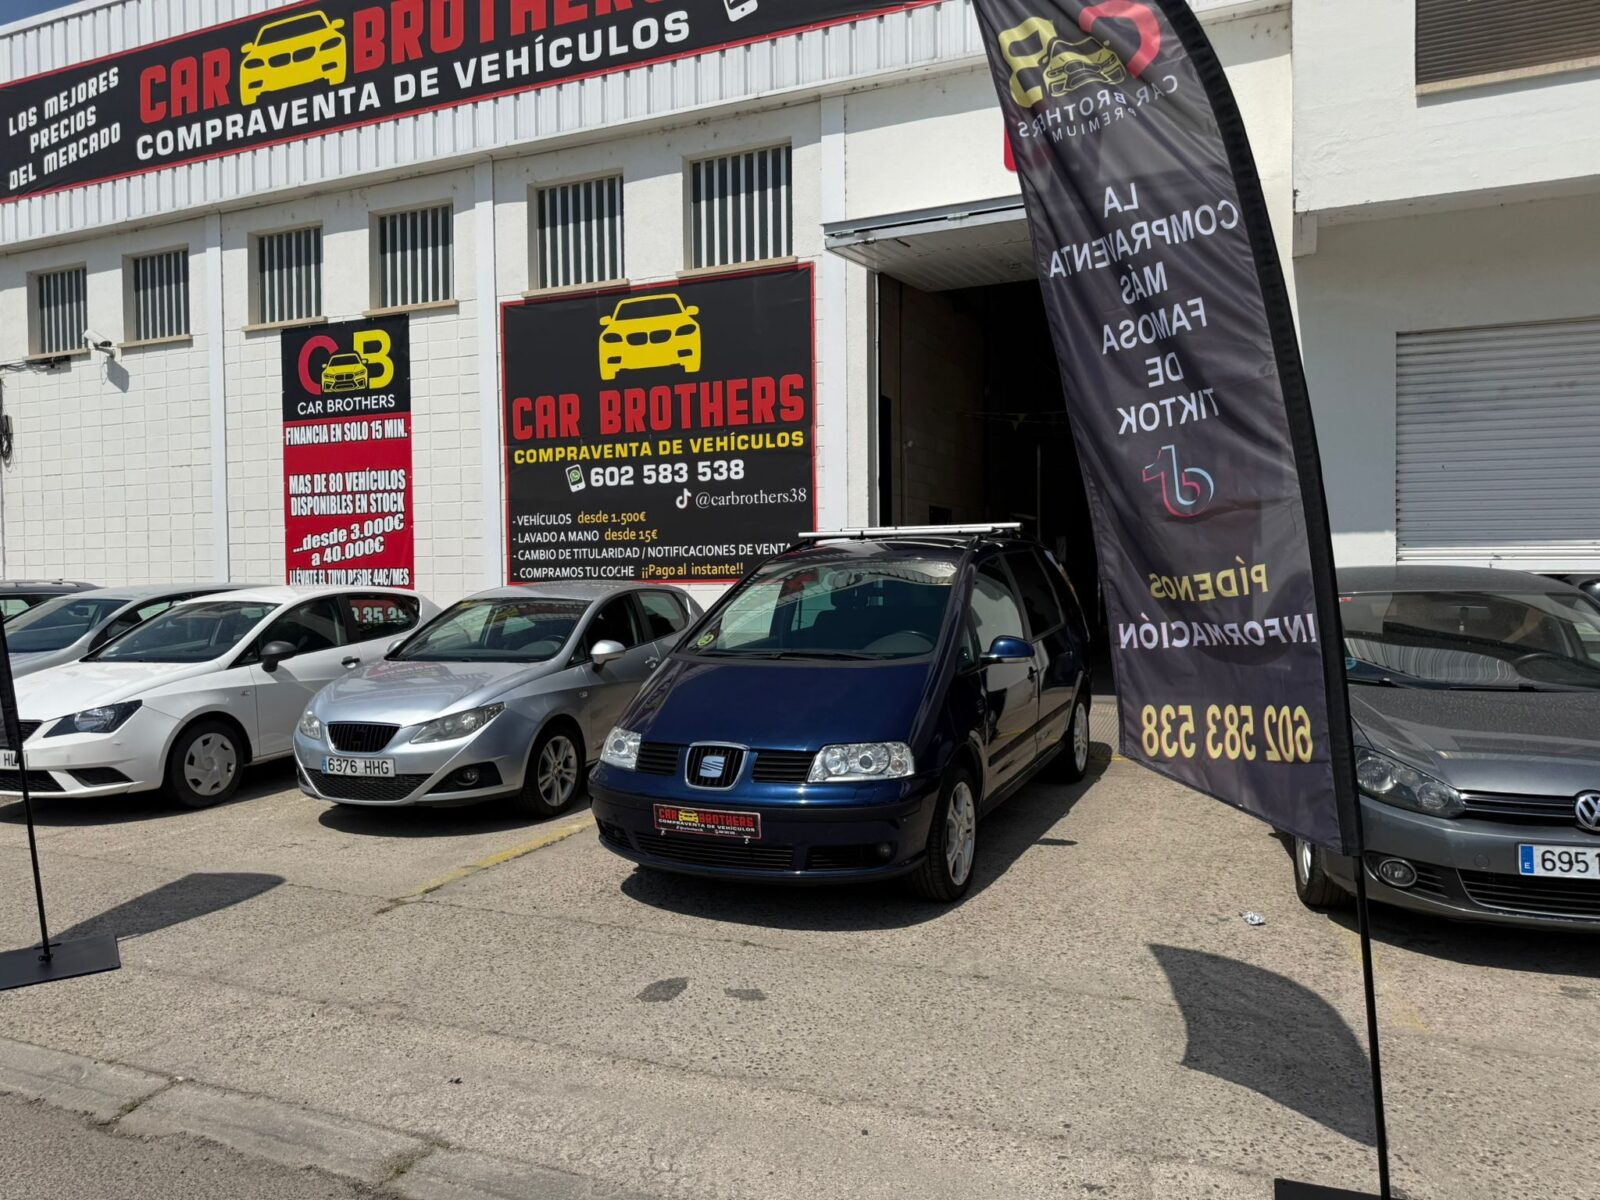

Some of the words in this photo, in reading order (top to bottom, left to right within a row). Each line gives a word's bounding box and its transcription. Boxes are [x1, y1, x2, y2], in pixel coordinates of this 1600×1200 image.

[139, 47, 231, 124] CAR
[353, 0, 664, 73] BROTH
[136, 82, 381, 161] COMPRAVENTA
[394, 67, 439, 104] DE
[453, 10, 689, 89] VEHÍCULOS
[9, 106, 37, 136] LOS
[44, 66, 119, 117] MEJORES
[30, 105, 97, 153] PRECIOS
[9, 165, 37, 190] DEL
[44, 122, 121, 175] MERCADO
[297, 400, 324, 415] CAR
[326, 394, 395, 413] BROTHERS
[512, 393, 580, 440] CAR
[599, 373, 804, 435] BROTHERS
[285, 424, 329, 446] FINANCIA
[329, 423, 342, 442] EN
[344, 421, 369, 442] SOLO
[370, 420, 383, 440] 15
[384, 418, 408, 439] MIN.
[513, 441, 652, 465] COMPRAVENTA
[658, 438, 683, 456] DE
[689, 430, 805, 454] VEHÍCULOS
[288, 474, 312, 495] MAS
[313, 473, 327, 494] DE
[328, 472, 343, 493] 80
[344, 467, 406, 492] VEHÍCULOS
[590, 465, 634, 487] 602
[642, 463, 689, 485] 583
[697, 459, 745, 482] 538
[290, 494, 353, 516] DISPONIBLES
[355, 493, 368, 514] EN
[369, 492, 405, 513] STOCK
[695, 487, 807, 509] @carbrothers38
[350, 513, 404, 540] 3.000€
[516, 512, 572, 526] VEHÍCULOS
[577, 510, 609, 524] desde
[610, 511, 647, 525] 1.500€
[518, 531, 558, 543] LAVADO
[559, 531, 567, 542] A
[568, 530, 600, 542] MANO
[604, 527, 636, 541] desde
[638, 529, 658, 542] 15€
[311, 552, 320, 566] a
[323, 536, 385, 563] 40.000€
[517, 549, 557, 560] CAMBIO
[558, 548, 572, 560] DE
[572, 547, 640, 559] TITULARIDAD
[647, 544, 736, 558] NOTIFICACIONES
[738, 544, 754, 555] DE
[519, 566, 584, 579] COMPRAMOS
[585, 566, 599, 577] TU
[600, 565, 635, 577] COCHE
[677, 562, 687, 576] al
[328, 757, 358, 774] 6376
[364, 760, 389, 775] HHG
[658, 818, 705, 828] COMPRAVENTA
[659, 808, 677, 821] CAR
[699, 813, 754, 827] BROTHERS
